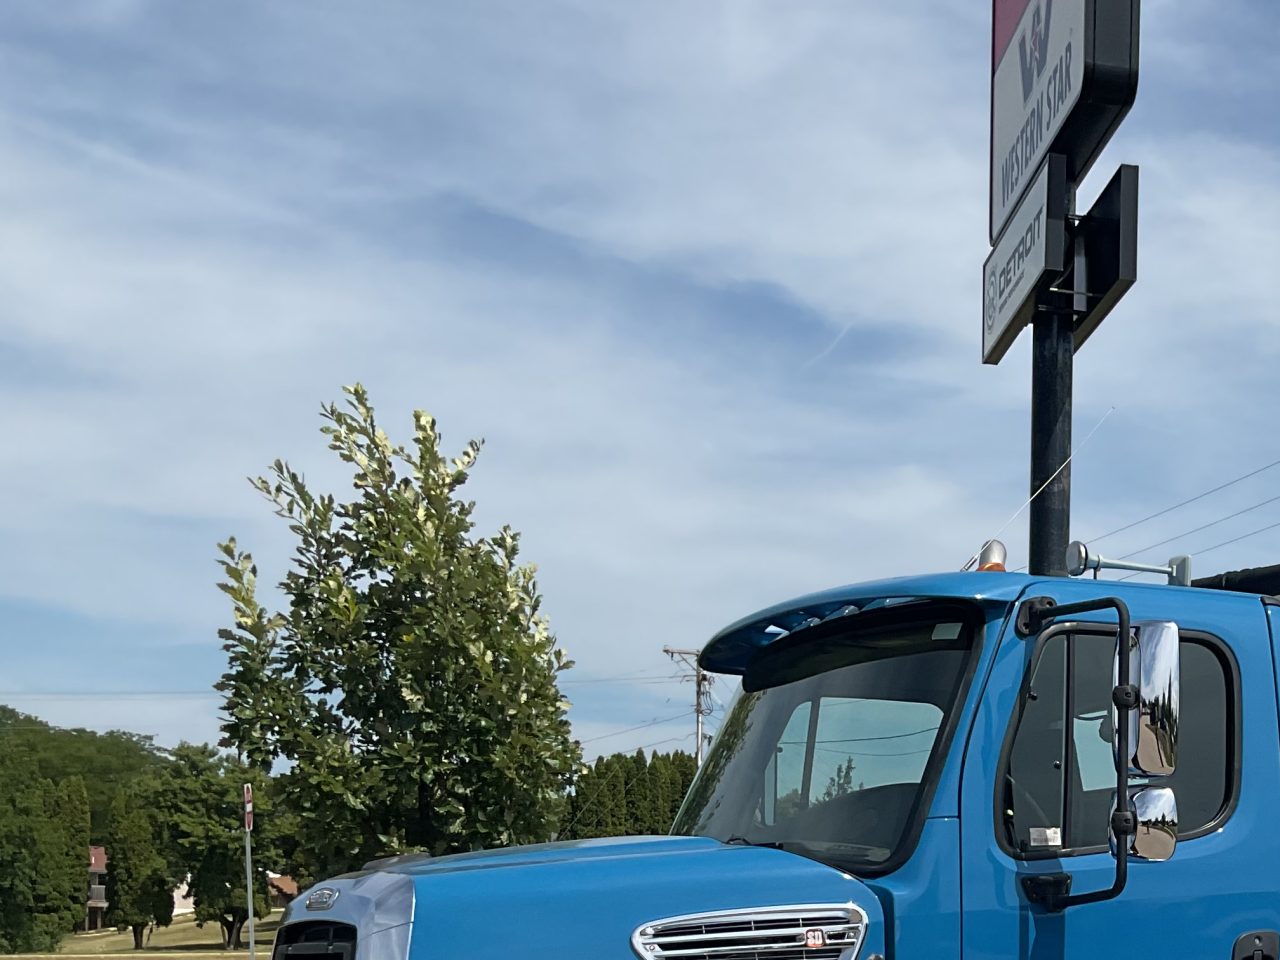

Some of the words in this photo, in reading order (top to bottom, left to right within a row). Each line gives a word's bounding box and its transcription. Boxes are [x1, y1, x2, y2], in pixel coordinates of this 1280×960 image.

[1002, 90, 1043, 208] WESTERN
[1046, 41, 1072, 131] STAR
[999, 204, 1045, 300] DETROIT
[807, 931, 823, 945] SD
